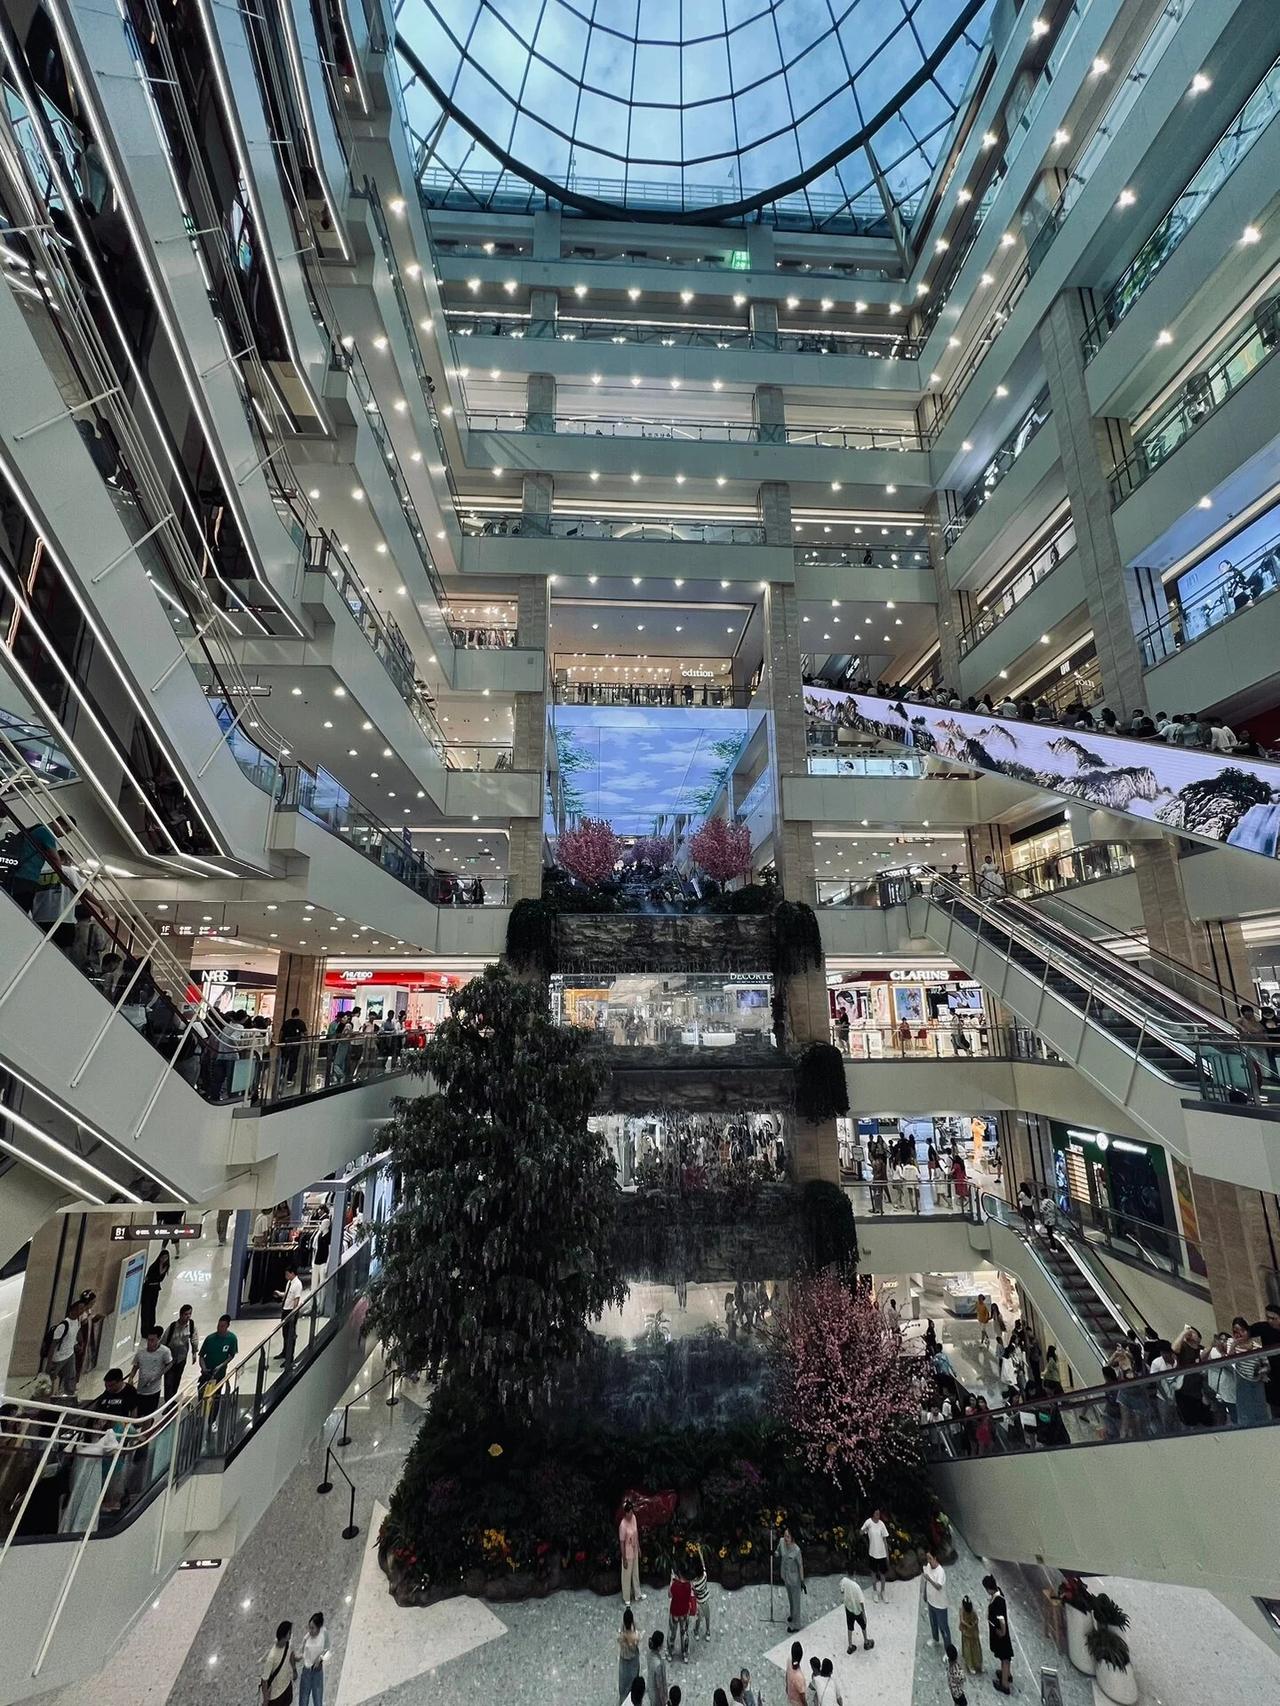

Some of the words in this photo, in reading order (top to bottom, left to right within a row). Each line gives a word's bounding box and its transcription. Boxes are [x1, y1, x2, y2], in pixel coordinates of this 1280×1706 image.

[682, 668, 714, 677] edition
[161, 925, 171, 933] 1F
[201, 970, 229, 982] NARS
[889, 970, 950, 982] CLARINS
[115, 1227, 126, 1236] B1
